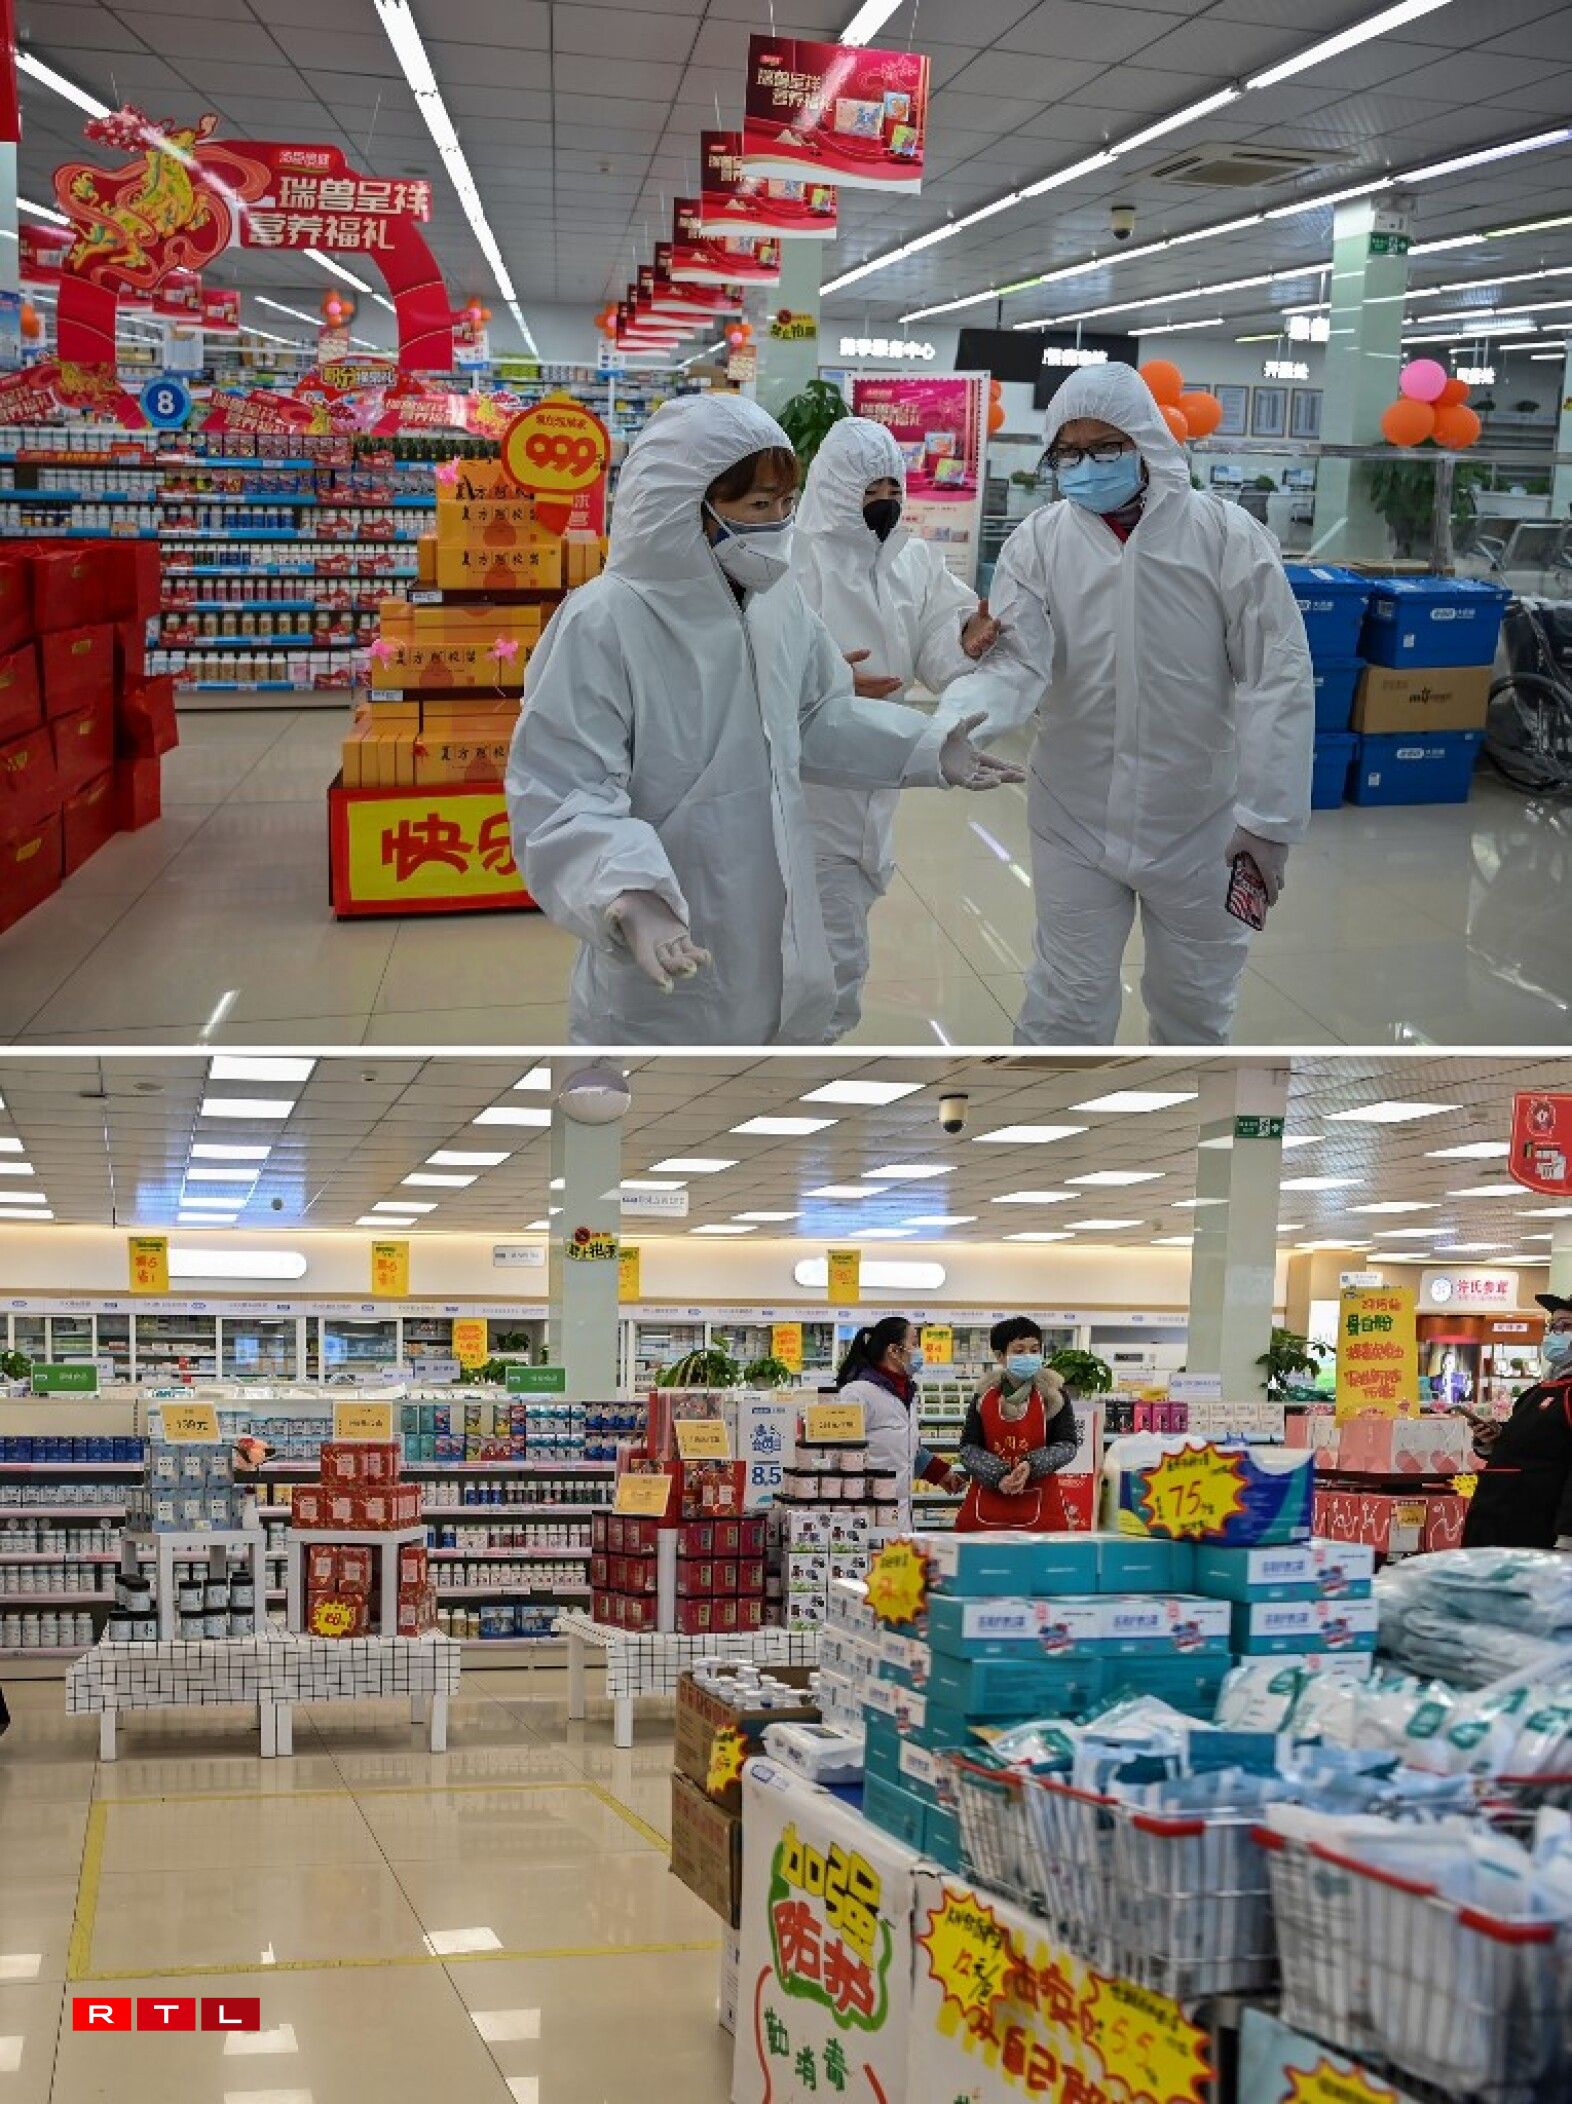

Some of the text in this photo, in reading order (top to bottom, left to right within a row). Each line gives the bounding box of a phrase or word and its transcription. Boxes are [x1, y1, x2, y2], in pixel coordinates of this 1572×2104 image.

[279, 176, 429, 217] 瑞兽呈祥
[249, 213, 396, 250] 营养福礼
[158, 390, 173, 413] 8
[751, 1466, 783, 1487] 8.5
[782, 1822, 881, 1970] 加强
[773, 1900, 874, 2016] 防护
